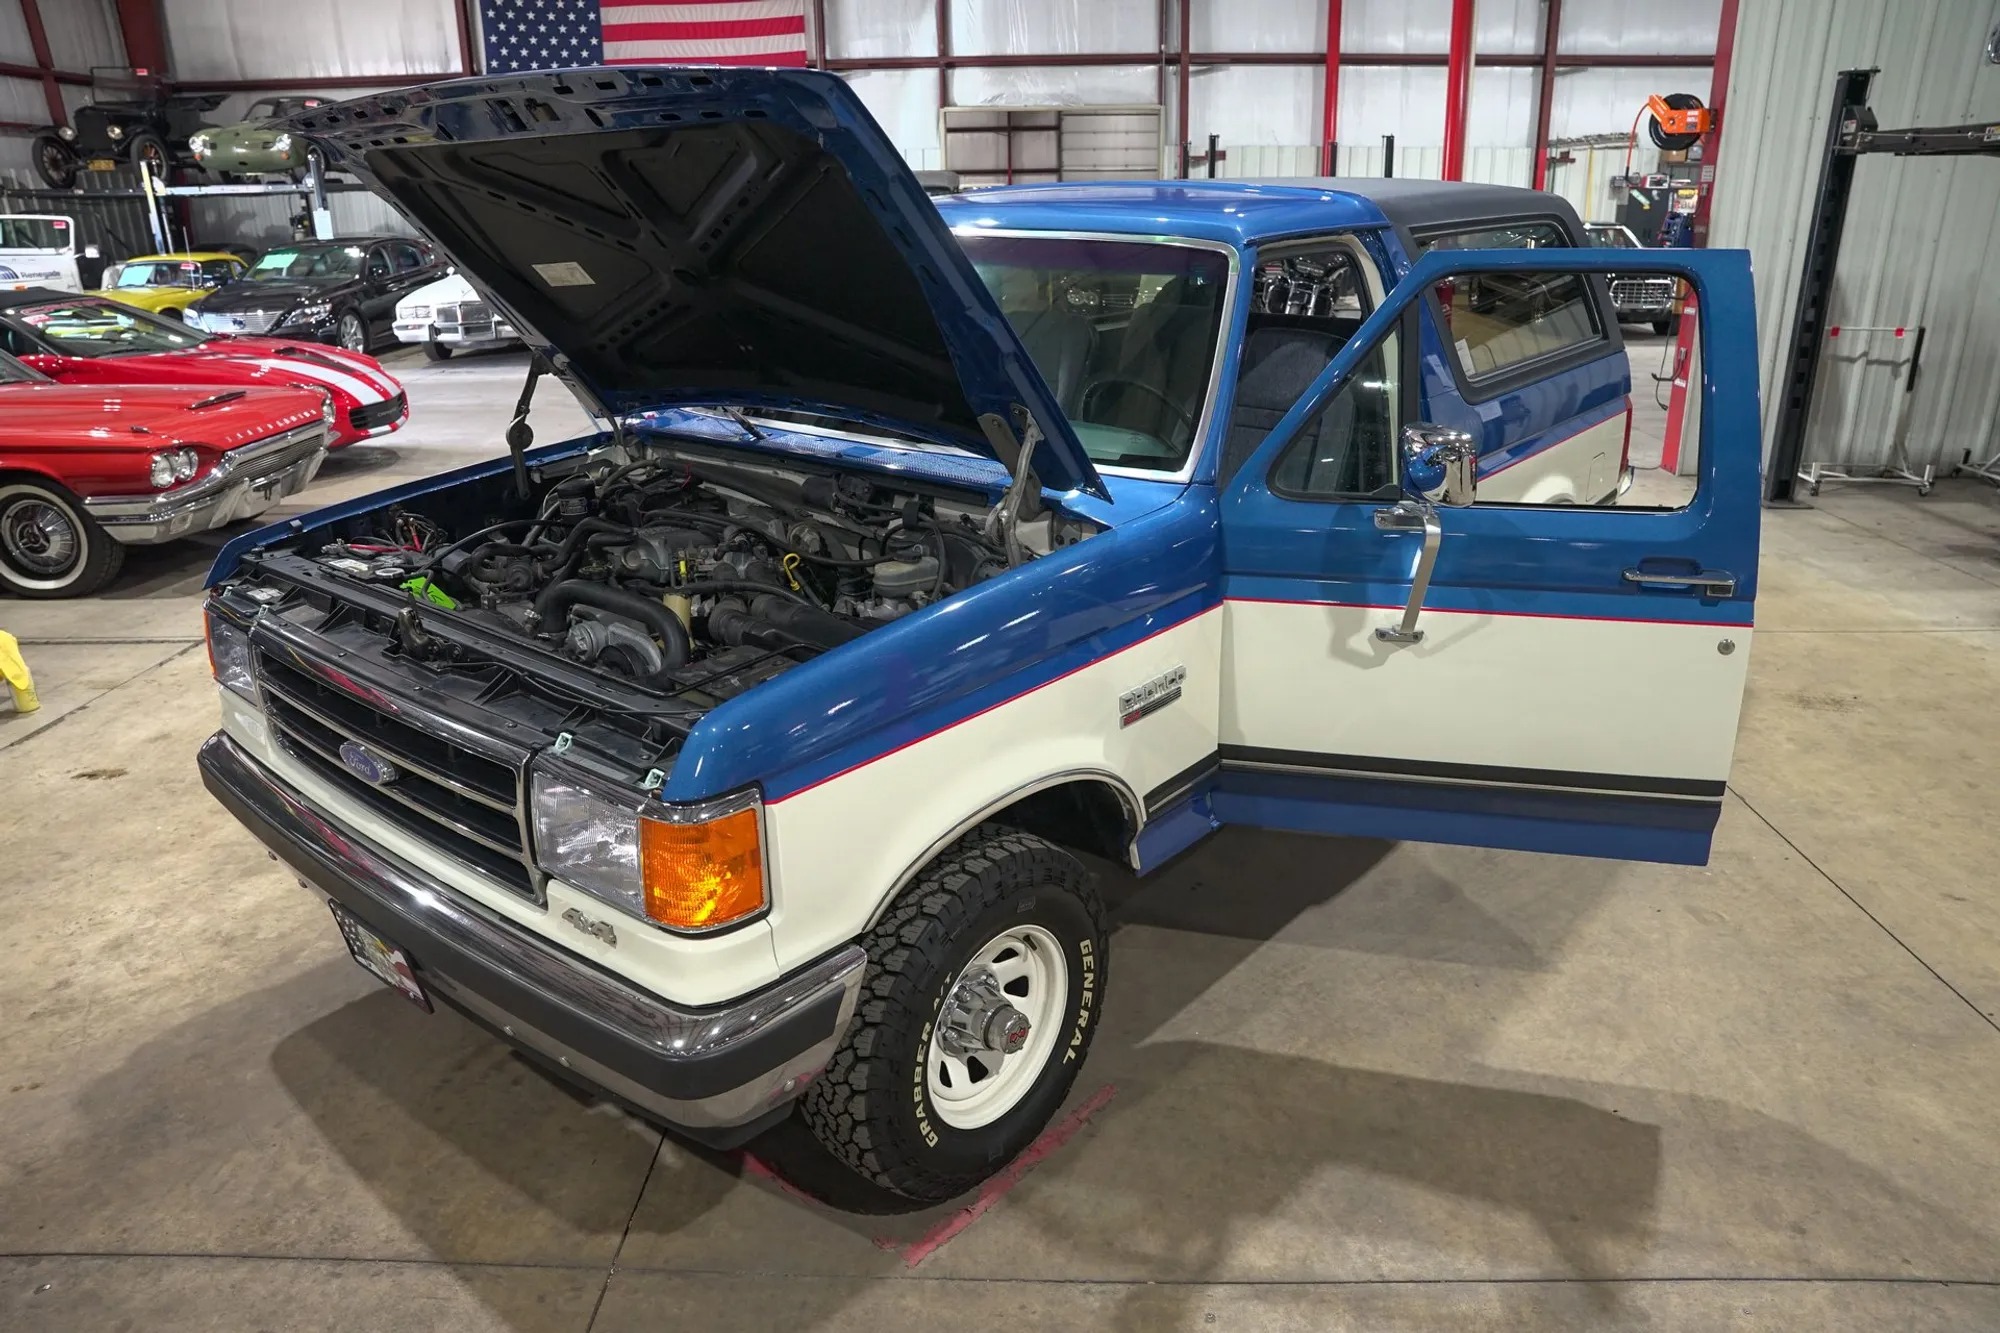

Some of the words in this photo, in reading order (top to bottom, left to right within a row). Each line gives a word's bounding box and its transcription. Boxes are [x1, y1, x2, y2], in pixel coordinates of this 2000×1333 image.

[20, 270, 61, 280] Renegade
[1119, 665, 1187, 715] BRONCO
[348, 751, 372, 775] Ford
[1063, 939, 1095, 1065] GENERAL
[913, 1021, 939, 1148] GRABBER
